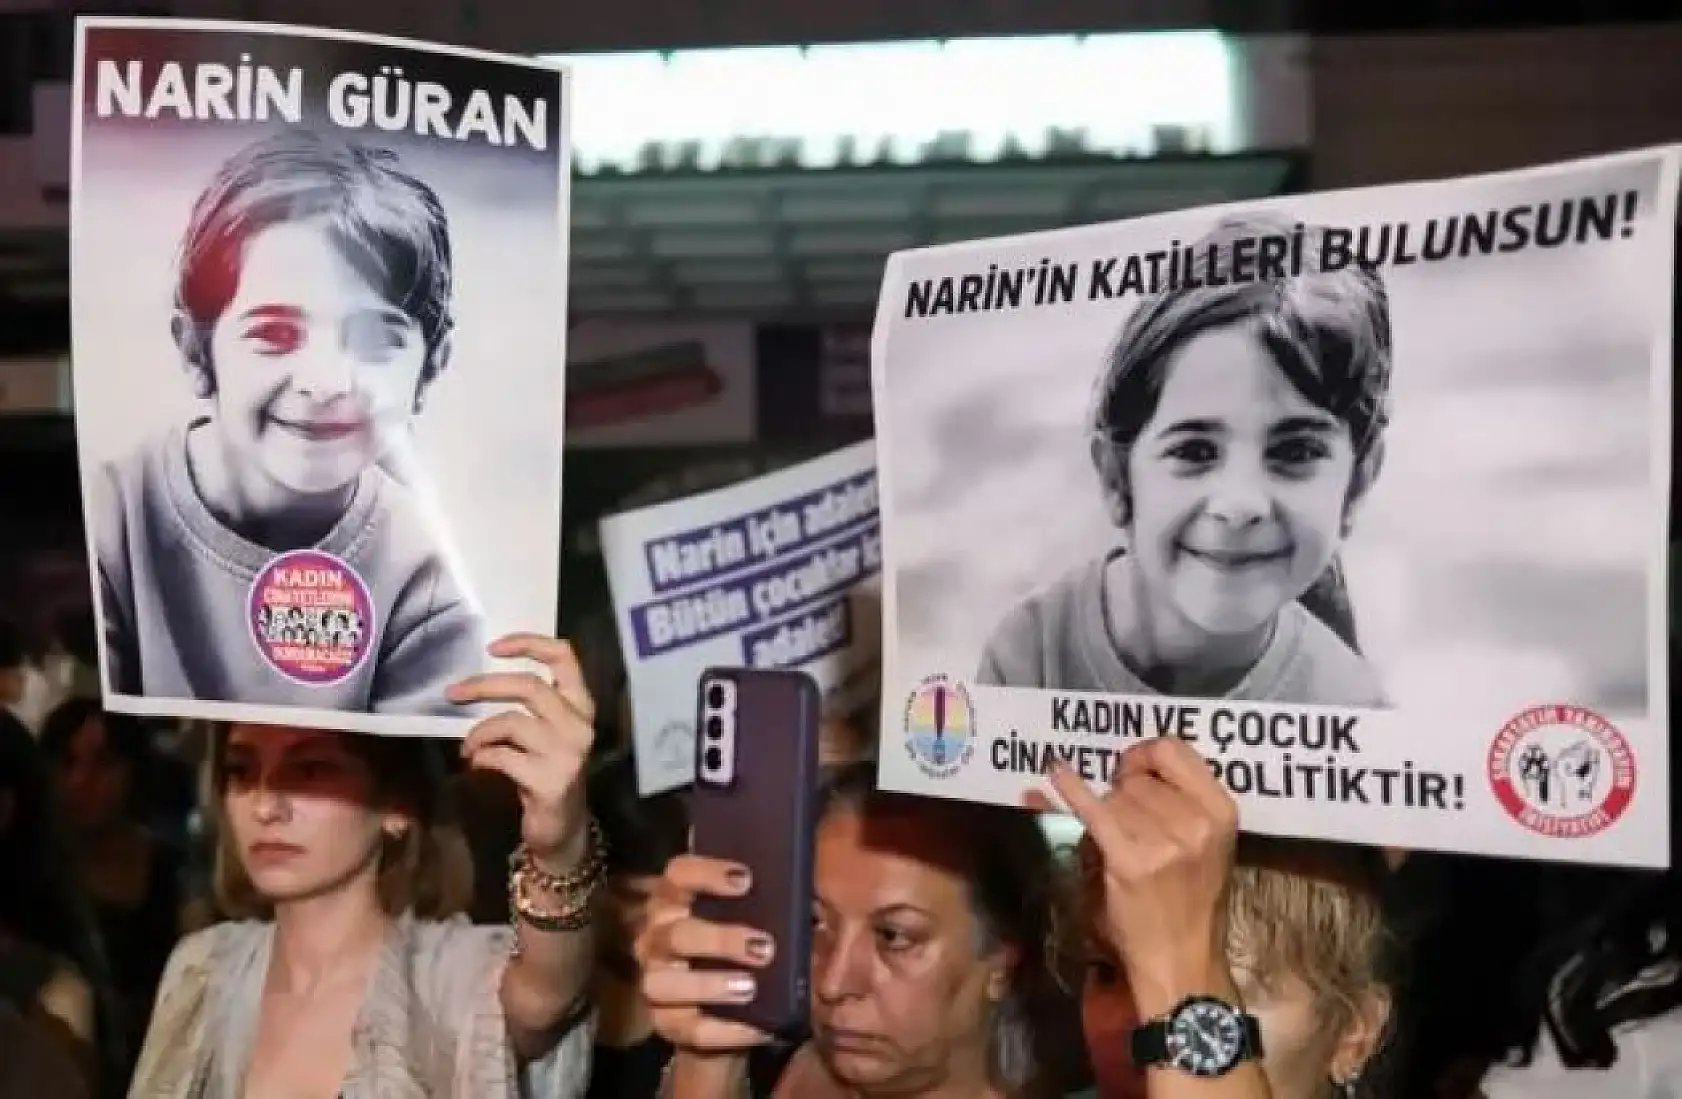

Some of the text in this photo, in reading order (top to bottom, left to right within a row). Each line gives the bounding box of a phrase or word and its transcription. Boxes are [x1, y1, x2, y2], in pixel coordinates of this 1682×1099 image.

[97, 53, 547, 150] NARİN GÜRAN
[905, 190, 1638, 318] NARİN'İN KATİLLERİ BULUNSUN!
[653, 527, 746, 584] Narin
[648, 588, 748, 646] Bütün
[1052, 697, 1361, 753] KADIN VE ÇOCUK
